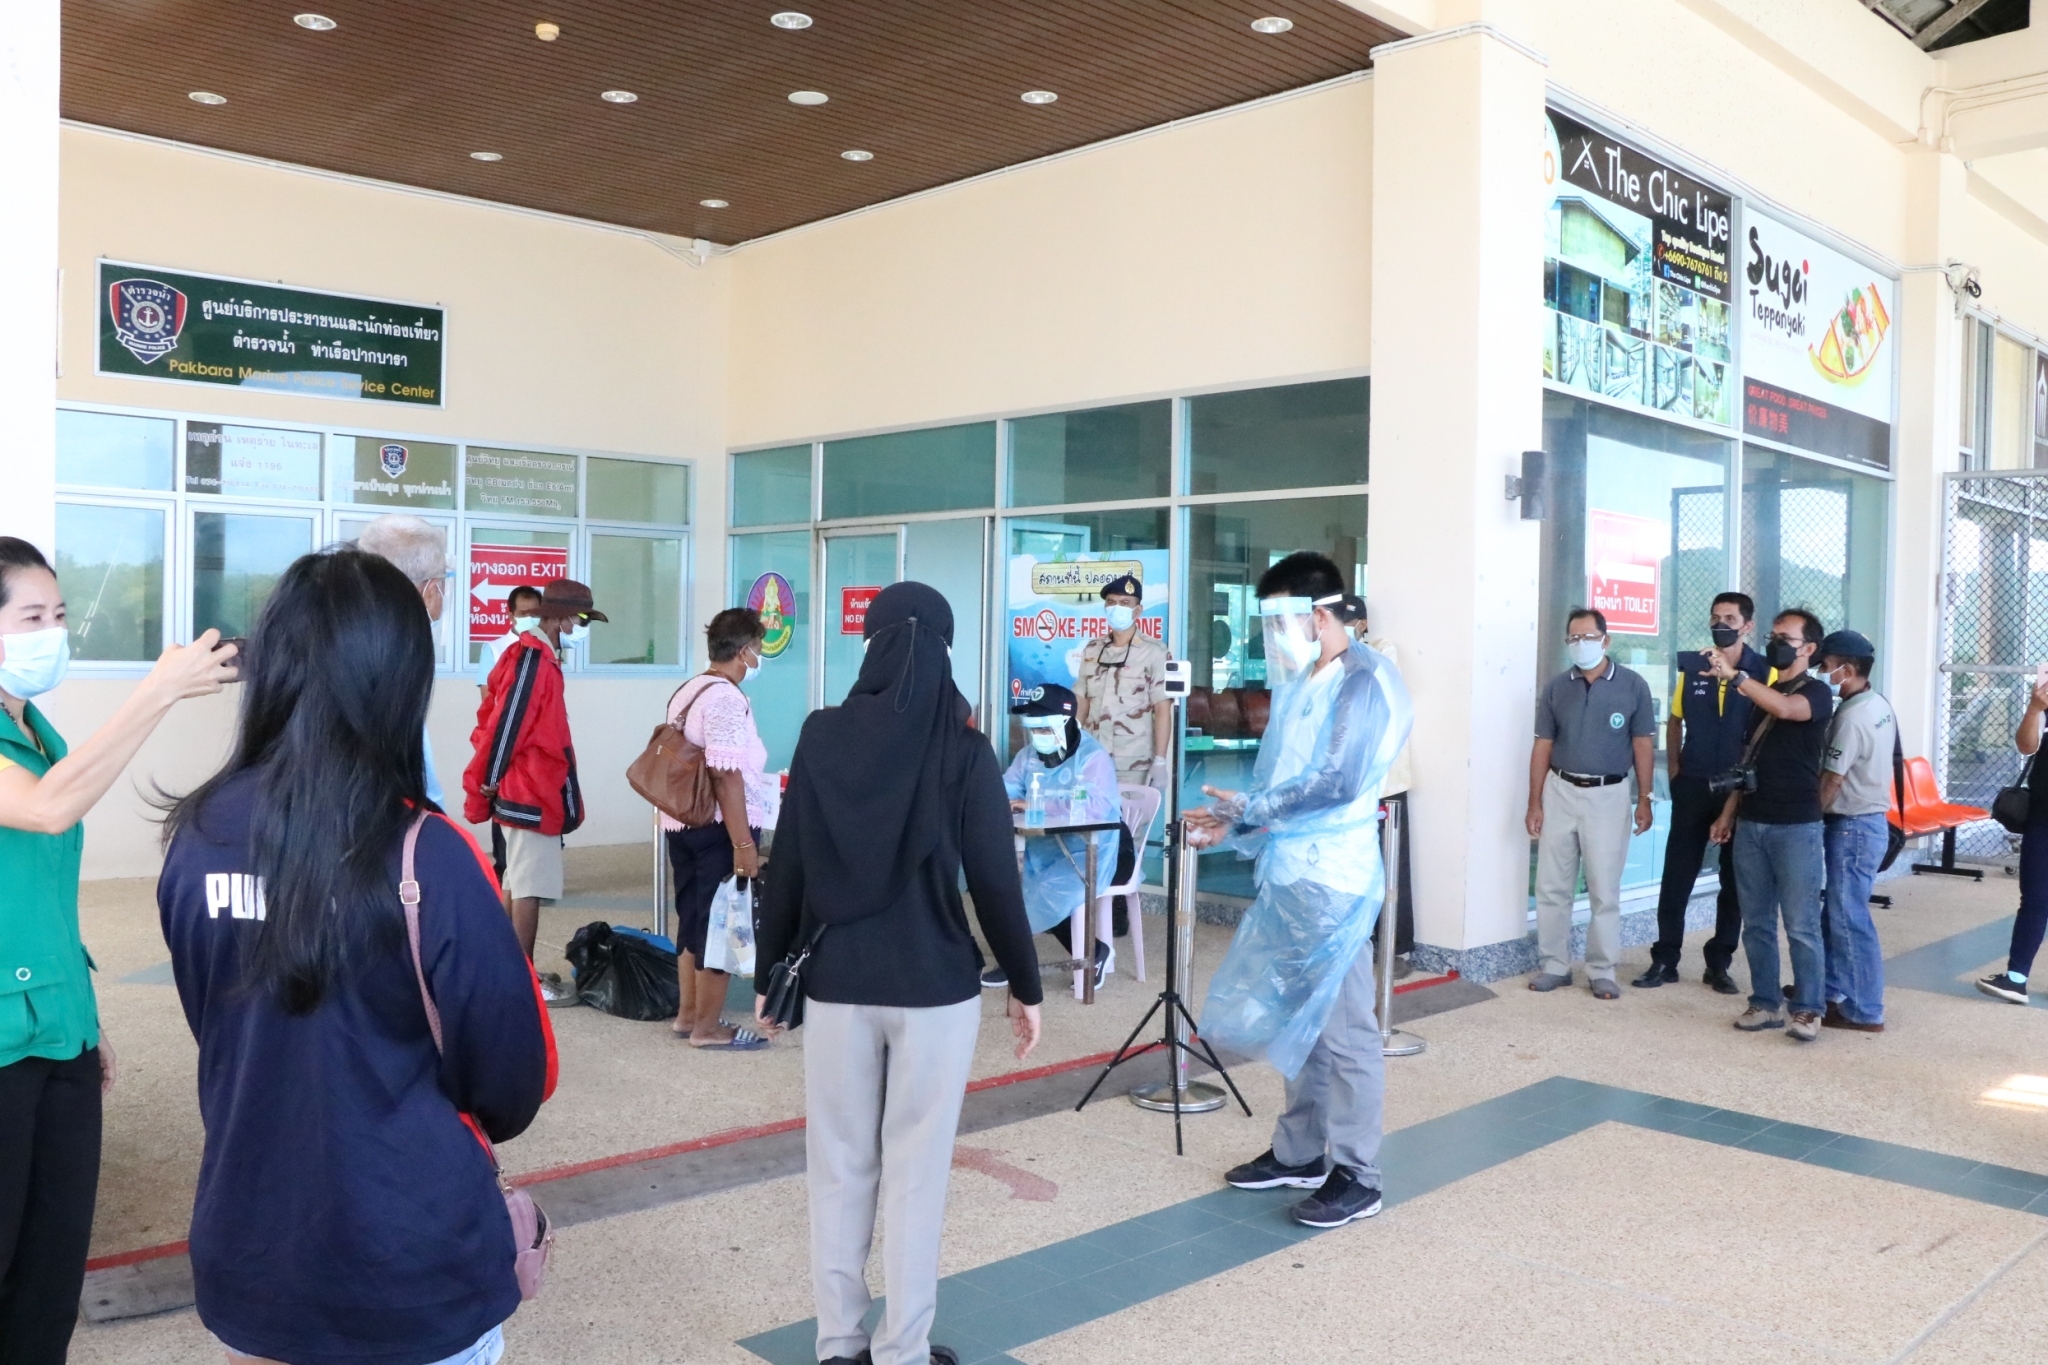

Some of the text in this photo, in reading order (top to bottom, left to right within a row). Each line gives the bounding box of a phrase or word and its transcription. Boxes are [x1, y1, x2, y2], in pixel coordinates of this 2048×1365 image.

[1605, 146, 1641, 203] The
[1649, 169, 1689, 225] Chic
[1696, 191, 1729, 249] Lipe
[202, 297, 439, 342] ศูนย์บริการประชาชนและนักท่องเที่ยว
[1749, 289, 1806, 338] Teppanyaki
[233, 329, 408, 368] ตำรวจน้ำ ท่าเรือปากบารา
[169, 358, 233, 379] Pakbara
[239, 365, 288, 384] Marine
[294, 371, 336, 389] Police
[391, 382, 435, 400] Center
[281, 436, 319, 451] ในทะเล
[230, 456, 282, 471] แจ้ง 1196
[471, 561, 567, 577] ทางออก EXIT
[850, 597, 871, 609] ห้ามเข้
[1624, 596, 1655, 614] TOILET
[844, 614, 854, 623] NO
